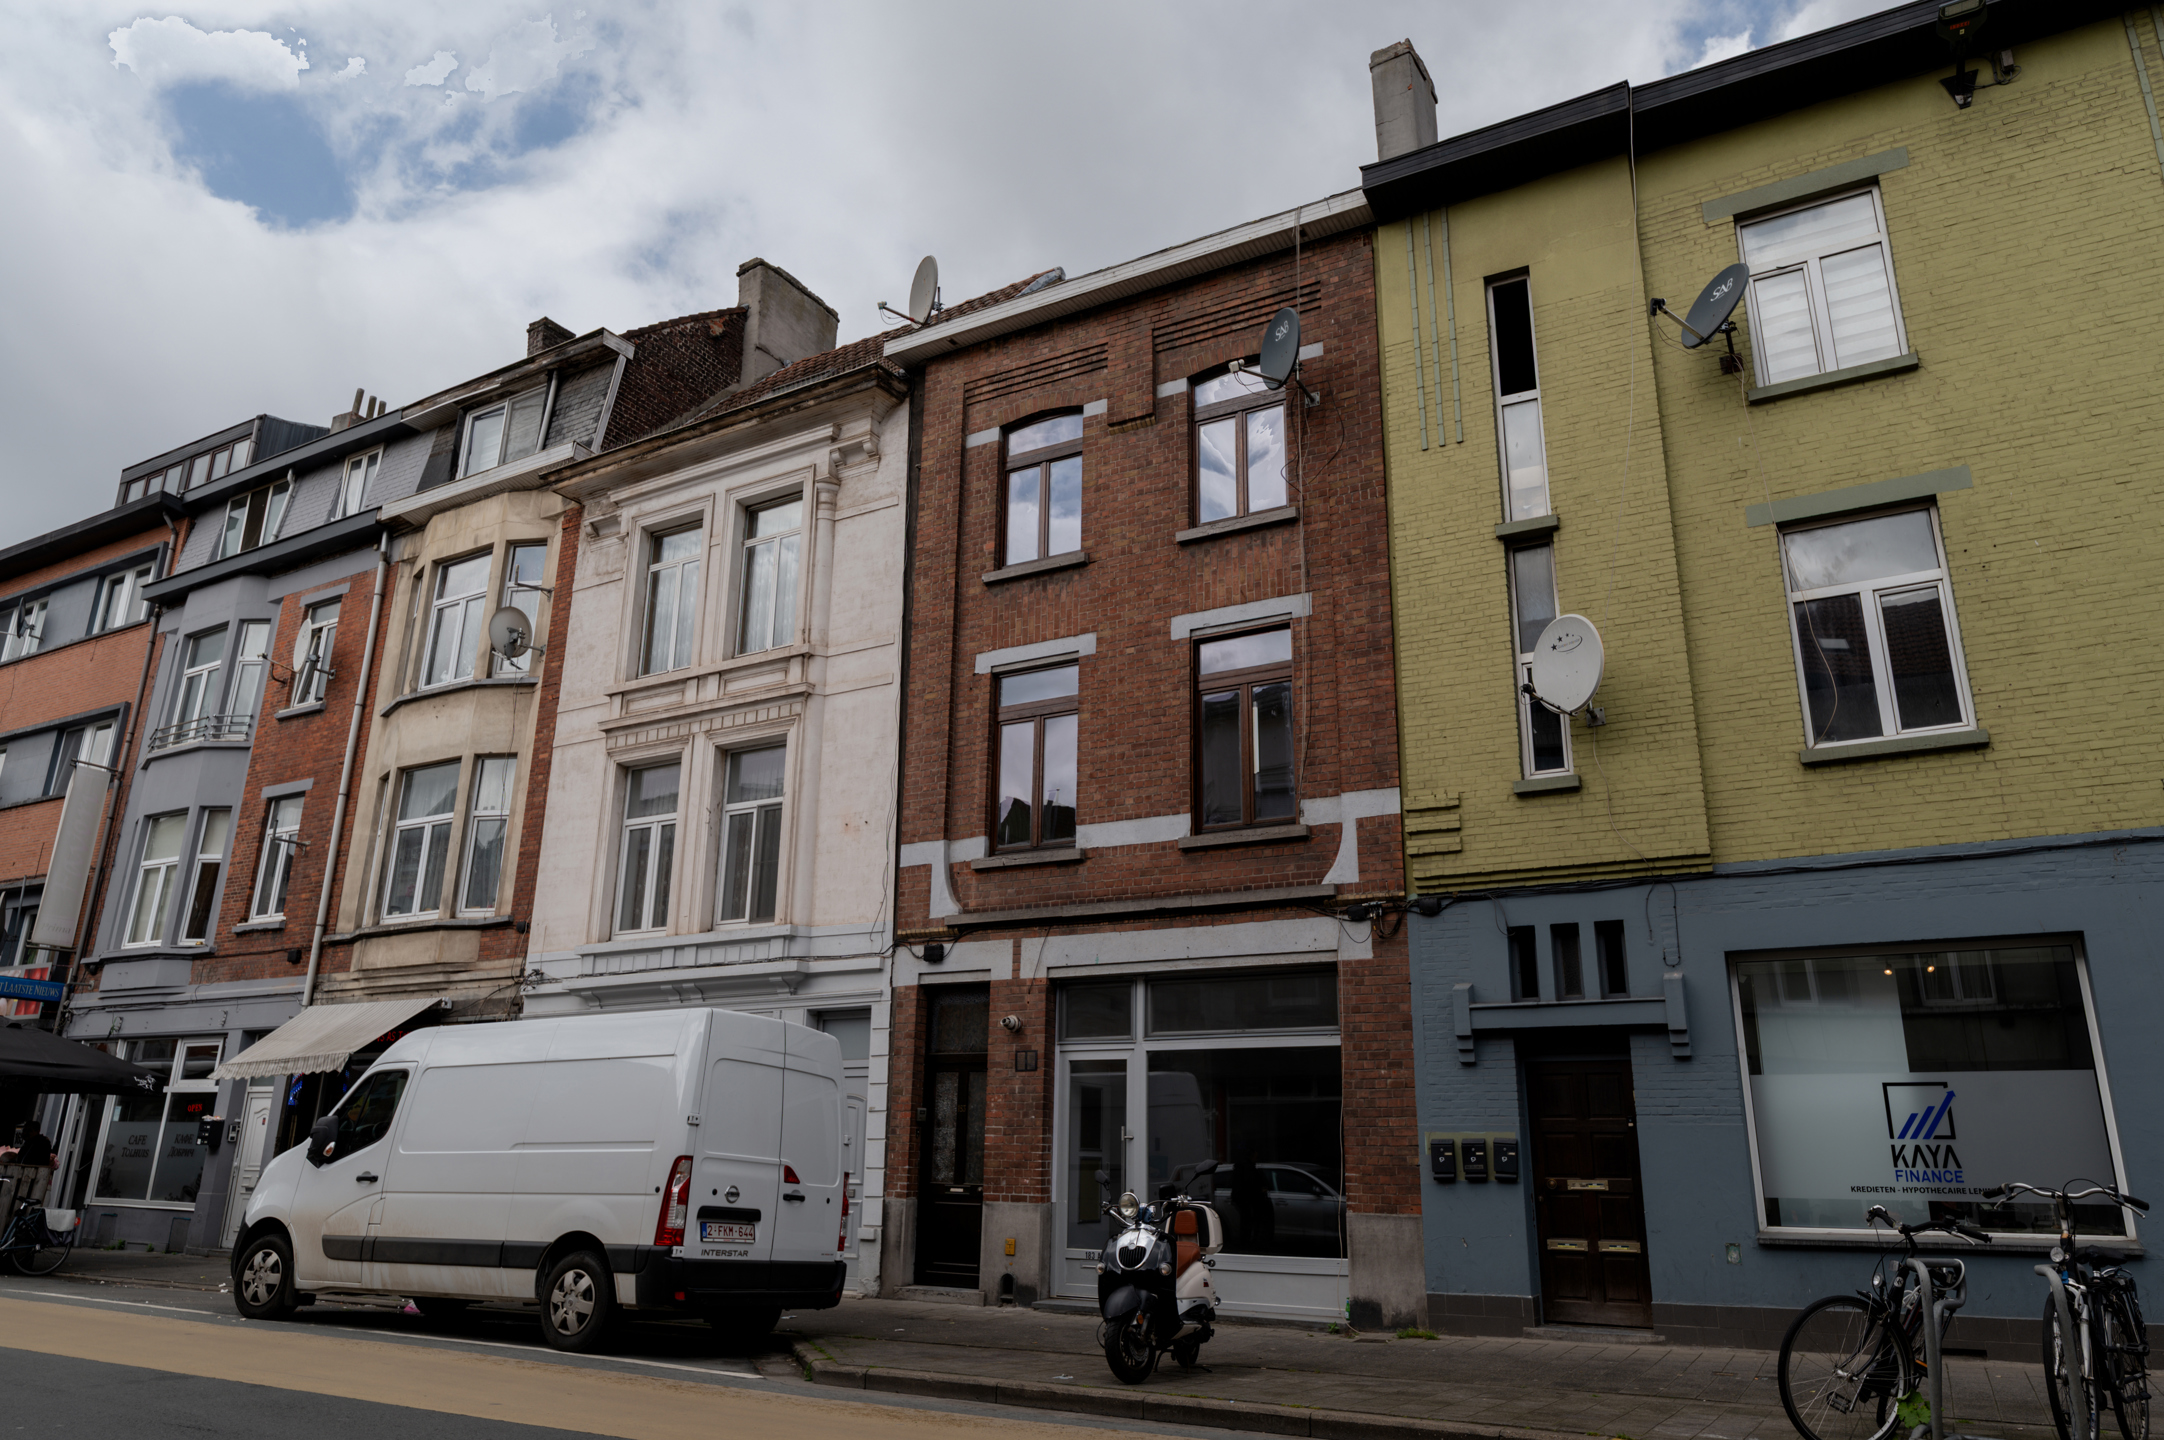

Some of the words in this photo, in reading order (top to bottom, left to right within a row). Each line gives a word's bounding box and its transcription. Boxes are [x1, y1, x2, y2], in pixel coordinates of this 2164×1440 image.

[3, 981, 34, 995] LAATSTE
[33, 984, 60, 998] NIEUWS
[187, 1103, 203, 1112] OPEN
[128, 1134, 147, 1146] CAFE
[1891, 1144, 1963, 1169] KAYA
[1895, 1170, 1965, 1184] FINANCE
[1850, 1185, 1896, 1194] KREDIETEN
[1902, 1186, 1967, 1195] HYPOTHECAIRE
[701, 1249, 749, 1257] INTERSTAR
[1085, 1251, 1096, 1260] 183
